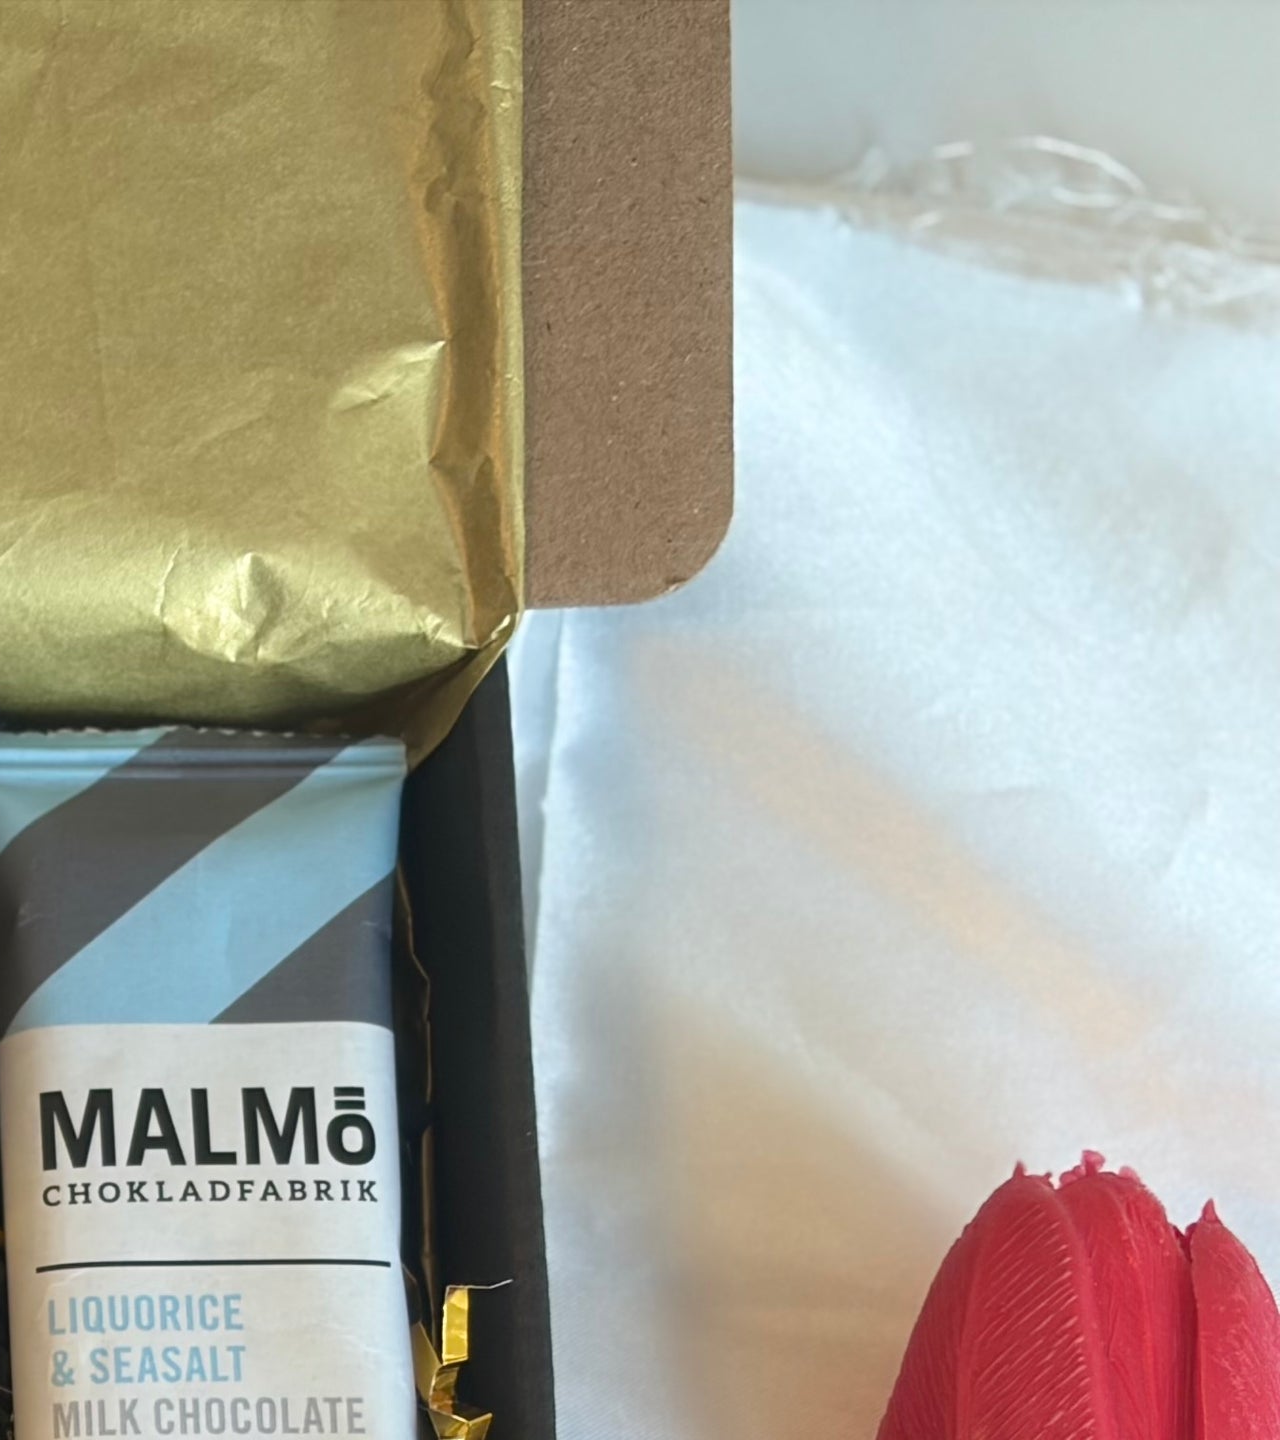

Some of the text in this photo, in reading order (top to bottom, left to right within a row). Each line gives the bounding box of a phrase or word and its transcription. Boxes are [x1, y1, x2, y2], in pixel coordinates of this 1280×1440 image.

[42, 1180, 379, 1207] CHOKLADFABRIK
[48, 1294, 245, 1335] LIQUORICE
[51, 1345, 247, 1387] & SEASALT
[53, 1396, 367, 1439] MILK CHOCOLATE
